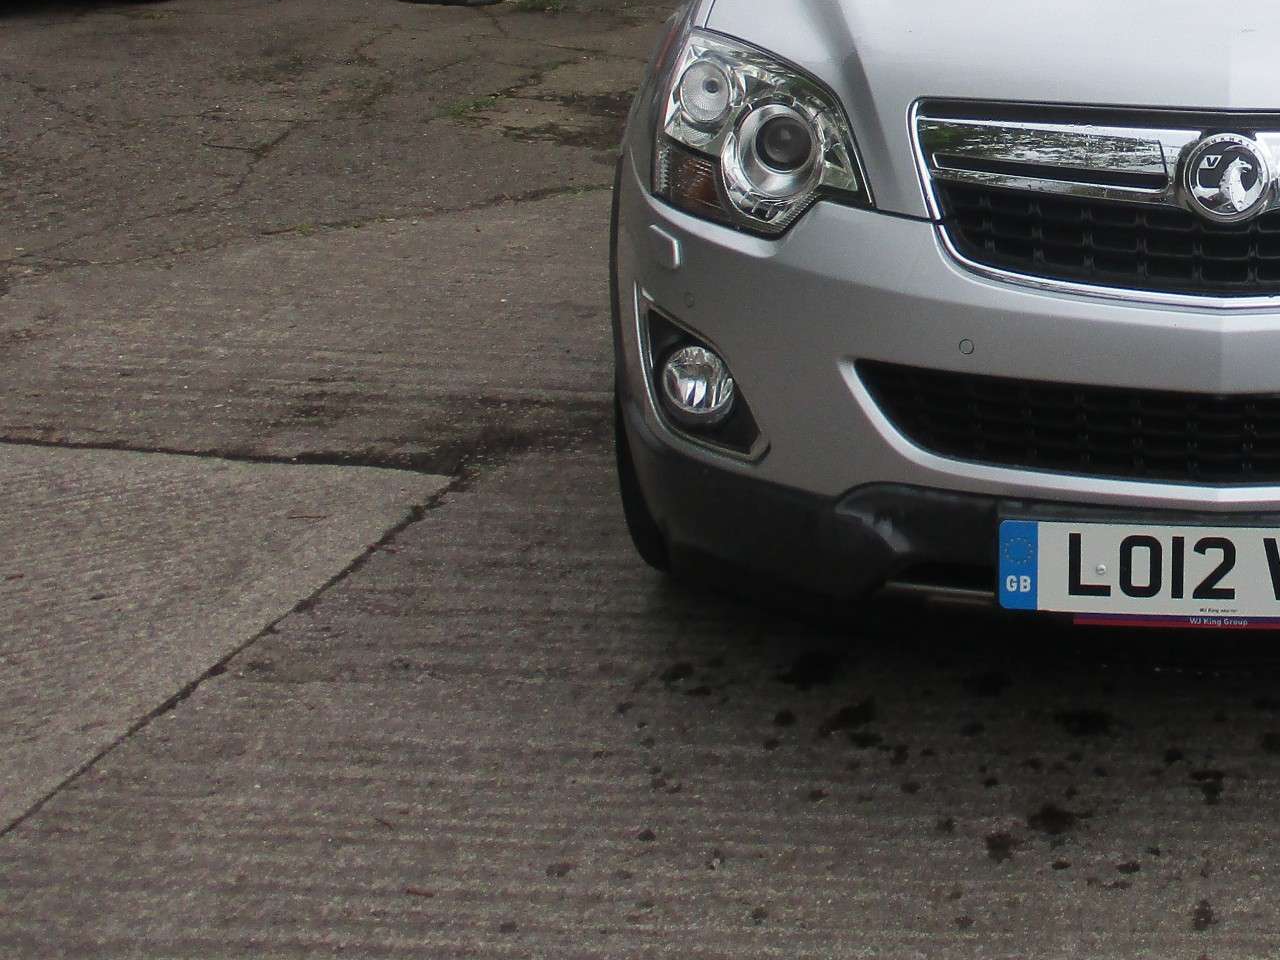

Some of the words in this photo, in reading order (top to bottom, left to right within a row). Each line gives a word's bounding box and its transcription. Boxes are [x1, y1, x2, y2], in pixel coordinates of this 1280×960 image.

[1069, 533, 1236, 599] LO12
[1007, 576, 1030, 591] GB
[1203, 617, 1221, 626] King
[1223, 618, 1248, 627] Group
